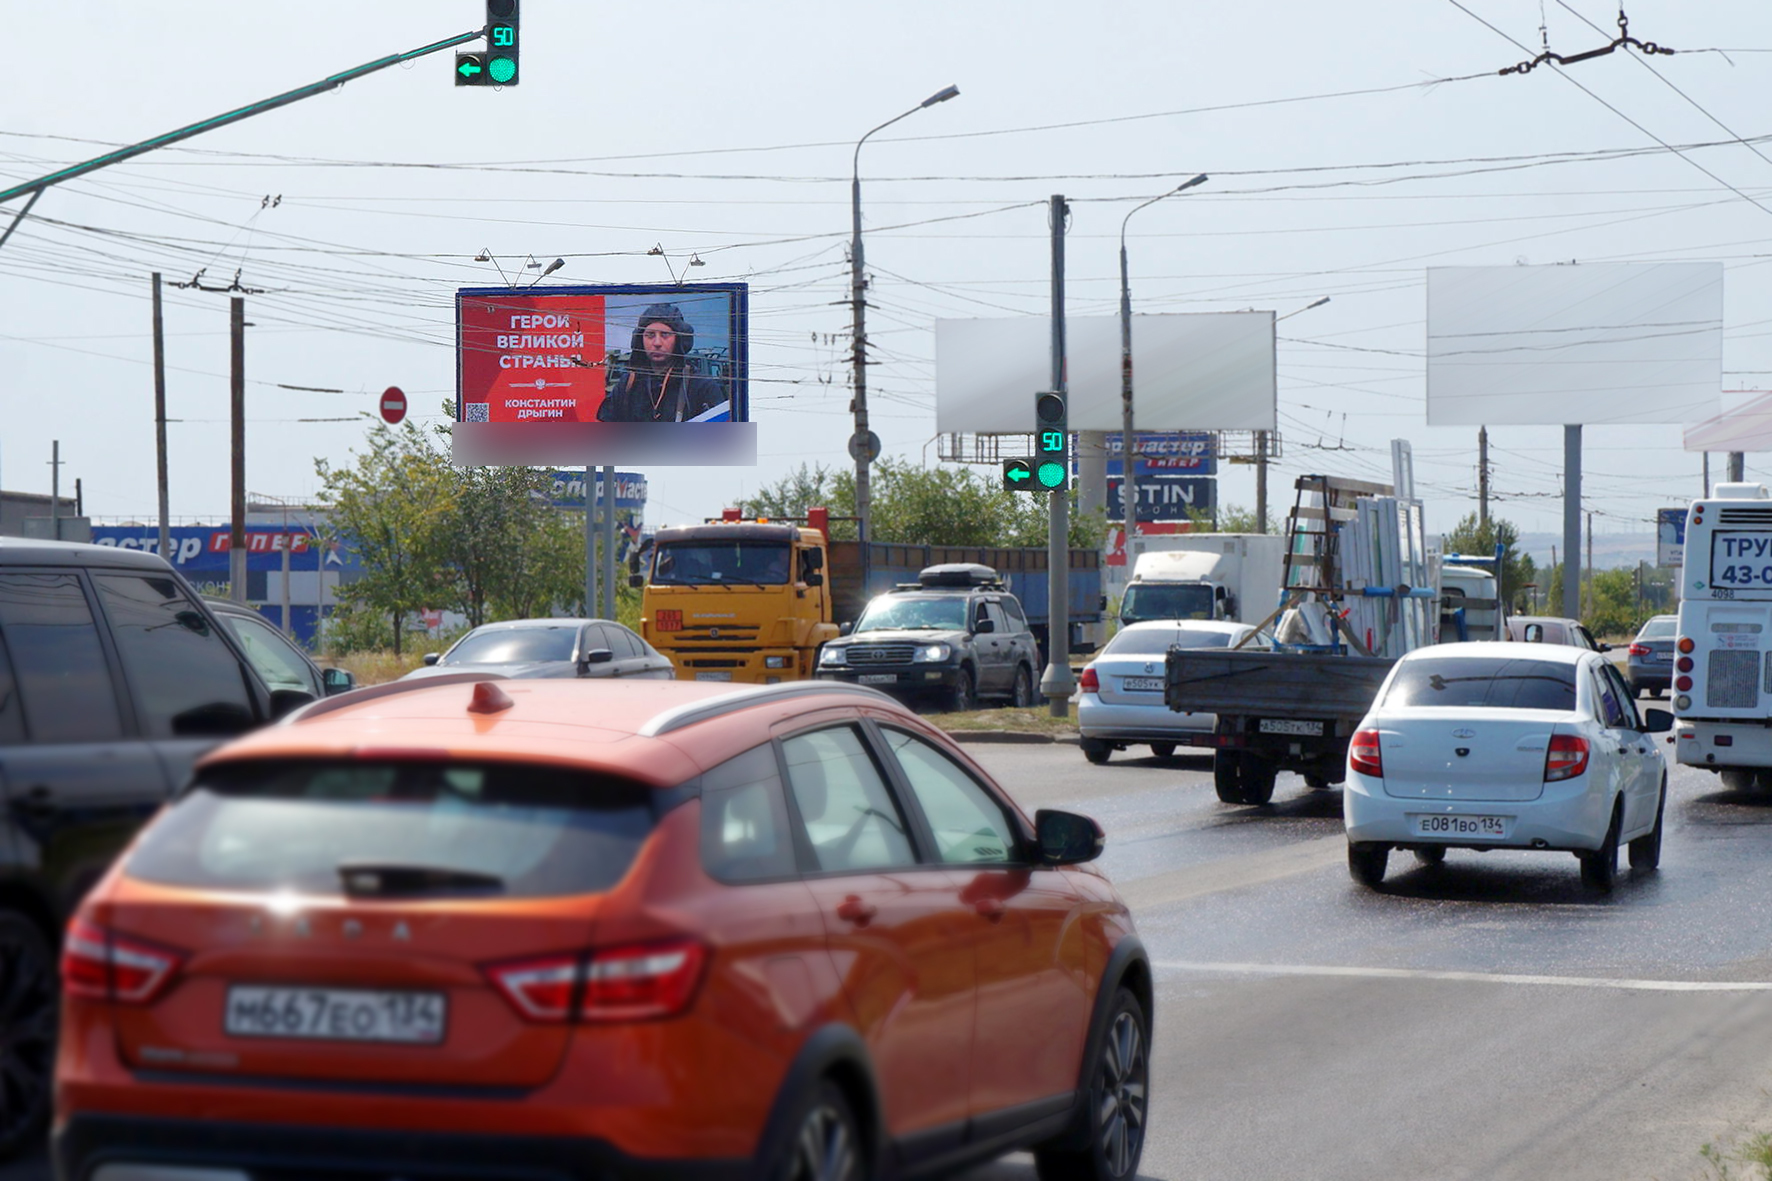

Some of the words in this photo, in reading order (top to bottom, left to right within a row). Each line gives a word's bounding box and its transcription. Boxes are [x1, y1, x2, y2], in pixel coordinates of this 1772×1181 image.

[493, 27, 514, 46] 50
[497, 331, 584, 348] ВЕЛИКОЙ
[499, 354, 582, 368] СТРАНЫ
[505, 399, 576, 408] КОНСТАНТИН
[517, 409, 563, 419] ДРЫГИН
[1042, 432, 1063, 451] 50
[214, 534, 304, 550] ГПЕР
[1722, 537, 1772, 558] ТРУ
[1711, 588, 1735, 599] 4098
[1422, 817, 1478, 832] Е081ВО
[1481, 817, 1503, 829] 134
[235, 990, 377, 1034] М667ЕО
